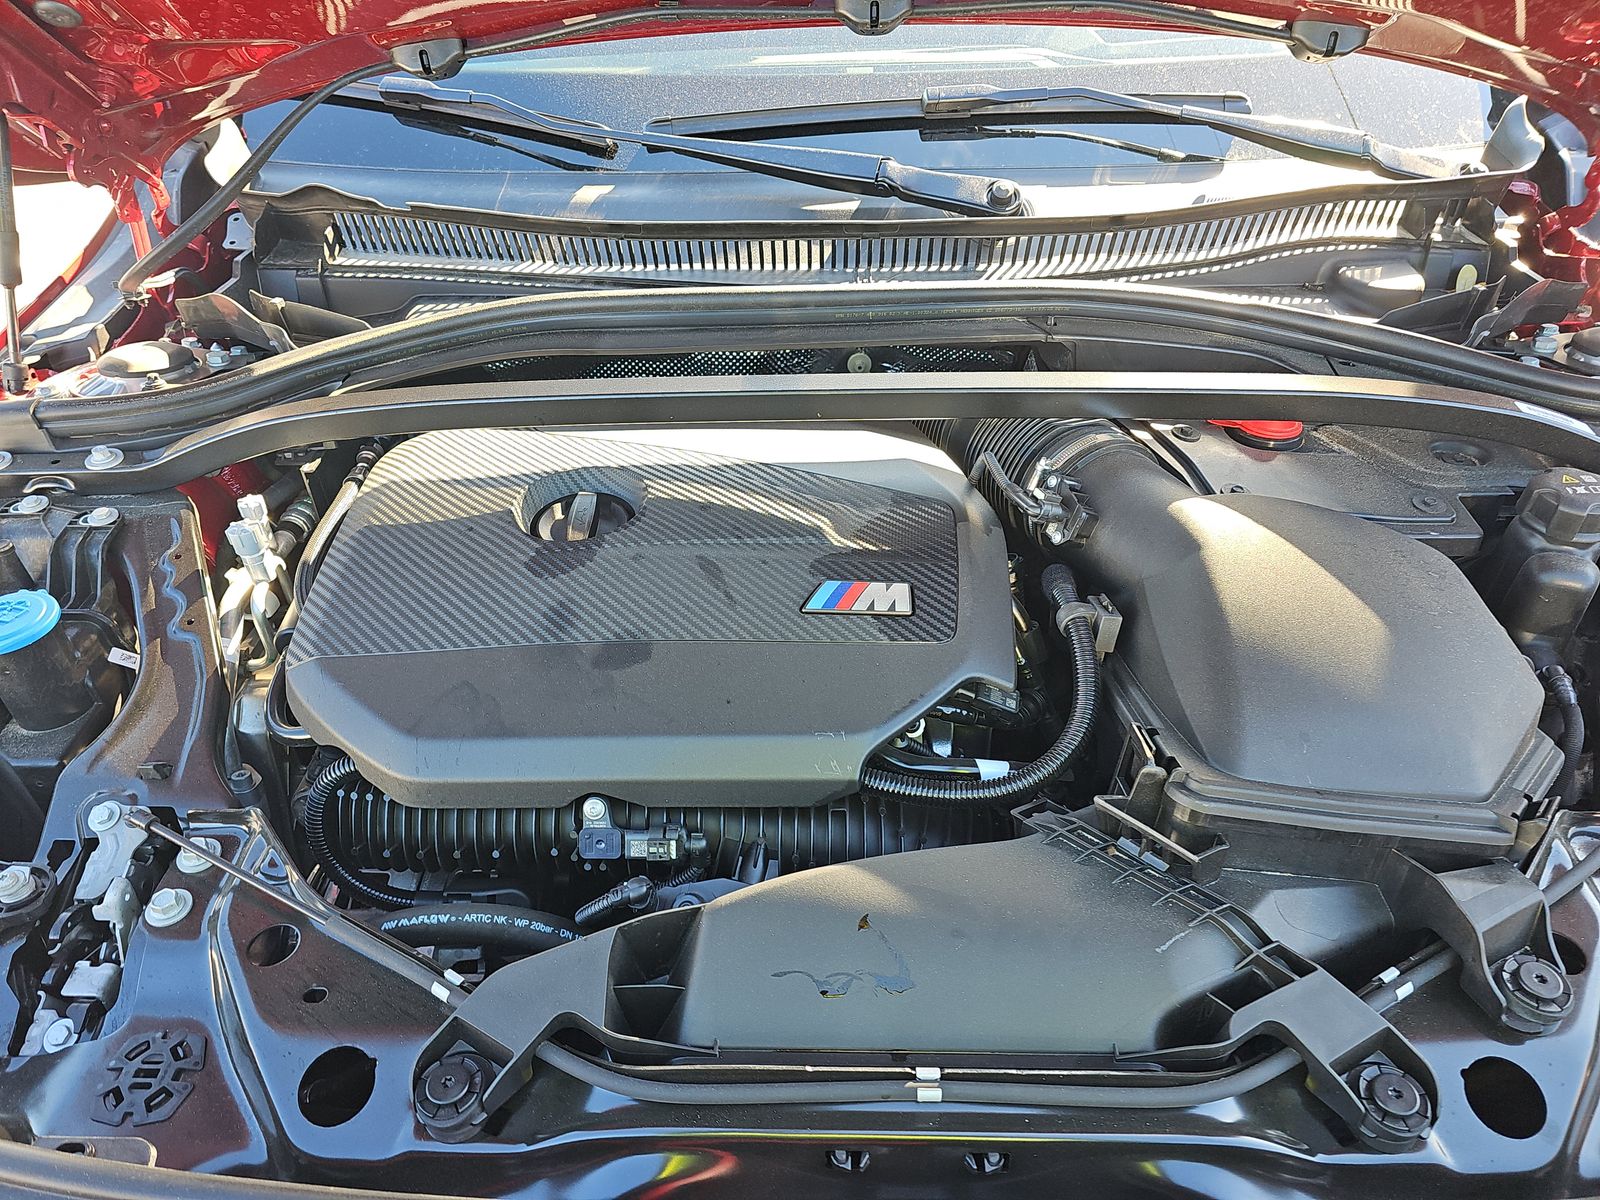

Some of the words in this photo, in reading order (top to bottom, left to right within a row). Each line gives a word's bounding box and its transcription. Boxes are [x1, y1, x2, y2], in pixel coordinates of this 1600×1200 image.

[851, 583, 910, 611] M
[463, 914, 492, 923] ARTIC
[493, 915, 507, 925] NK
[514, 917, 529, 928] WP
[530, 921, 554, 934] 20bar
[560, 928, 573, 940] DN
